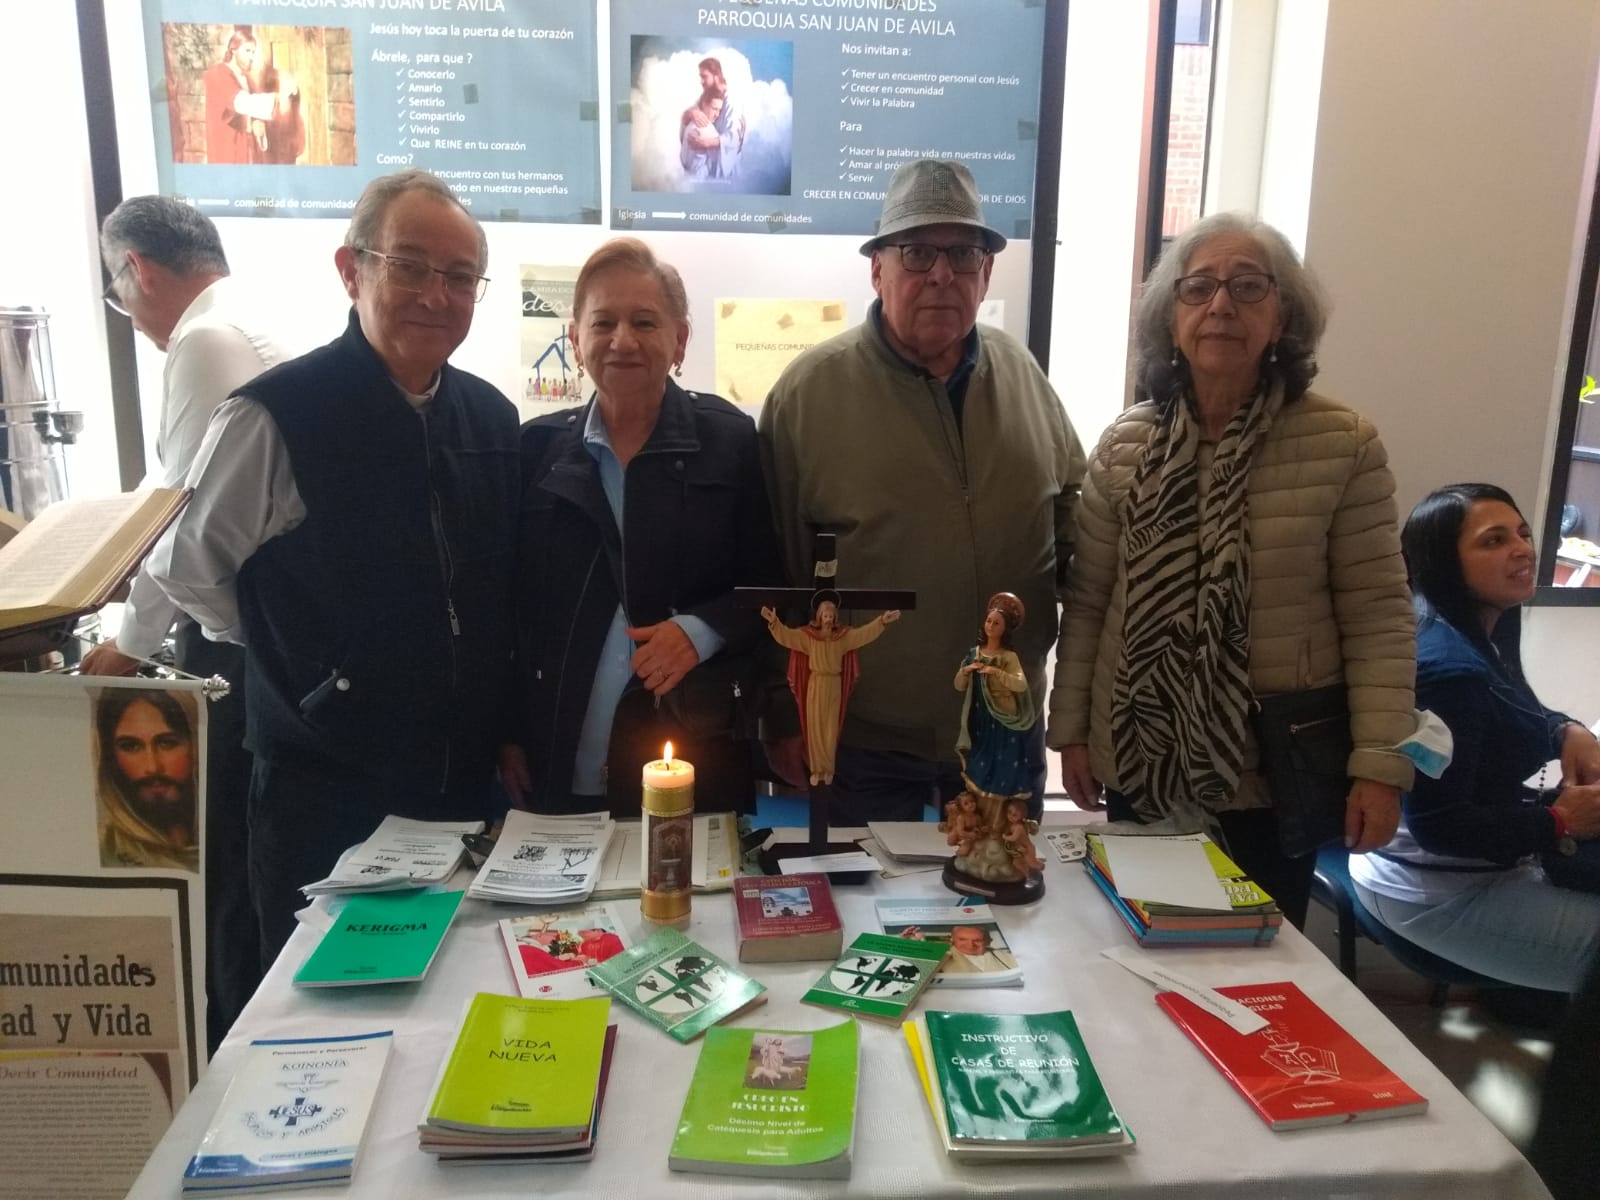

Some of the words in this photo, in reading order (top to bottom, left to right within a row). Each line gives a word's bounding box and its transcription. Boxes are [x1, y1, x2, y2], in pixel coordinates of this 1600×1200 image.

[379, 0, 425, 10] JUAN
[429, 0, 451, 11] DE
[456, 0, 505, 12] AVILA
[698, 8, 795, 30] PARROQUIA
[799, 14, 832, 31] SAN
[836, 16, 879, 33] JUAN
[884, 18, 905, 34] DE
[909, 20, 956, 37] AVILA
[369, 23, 399, 35] Jesús
[402, 24, 421, 37] hoy
[425, 26, 448, 36] toca
[450, 25, 460, 36] la
[463, 27, 499, 38] puerta
[501, 27, 516, 38] de
[518, 28, 529, 38] tu
[532, 28, 574, 40] corazón
[842, 43, 862, 54] Nos
[864, 44, 899, 56] invitan
[901, 48, 912, 57] a:
[371, 49, 411, 64] Ábrele,
[416, 54, 440, 65] para
[443, 54, 464, 65] que
[467, 53, 473, 63] ?
[408, 69, 455, 80] Conocerlo
[851, 69, 876, 80] Tener
[891, 72, 937, 82] encuentro
[939, 73, 977, 84] personal
[978, 76, 995, 84] con
[997, 75, 1020, 86] Jesús
[408, 83, 442, 93] Amarlo
[850, 83, 879, 94] Crecer
[881, 86, 893, 94] en
[895, 86, 944, 96] comunidad
[408, 97, 445, 107] Sentirlo
[850, 97, 870, 106] Vivir
[872, 98, 880, 107] la
[882, 98, 915, 109] Palabra
[409, 111, 465, 122] Compartirlo
[409, 124, 440, 135] Vivirlo
[840, 121, 863, 132] Para
[411, 138, 430, 149] Que
[435, 139, 463, 149] REINE
[464, 142, 476, 150] en
[478, 141, 489, 150] tu
[490, 140, 526, 151] corazón
[376, 153, 414, 166] Como?
[849, 147, 874, 157] Hacer
[876, 147, 885, 157] la
[887, 148, 919, 159] palabra
[922, 149, 940, 159] vida
[955, 151, 992, 161] nuestras
[993, 151, 1016, 161] vidas
[849, 160, 872, 170] Amar
[874, 160, 883, 170] al
[436, 168, 481, 180] encuentro
[483, 170, 500, 180] con
[501, 170, 516, 180] tus
[518, 170, 564, 181] hermanos
[849, 173, 874, 183] Servir
[448, 182, 467, 193] ndo
[469, 184, 482, 193] en
[484, 185, 522, 194] nuestras
[524, 183, 568, 195] pequeñas
[234, 197, 286, 208] comunidad
[287, 197, 299, 208] de
[803, 190, 837, 200] CRECER
[839, 191, 851, 200] EN
[991, 194, 1004, 203] DE
[1005, 194, 1026, 204] DIOS
[618, 209, 646, 221] Iglesia
[689, 210, 739, 222] comunidad
[741, 211, 752, 222] de
[753, 213, 812, 224] comunidades
[736, 341, 777, 351] PEQUEÑAS
[346, 922, 428, 932] KERIGMA
[0, 954, 156, 987] munidades
[0, 1004, 36, 1036] ad
[52, 1013, 72, 1043] y
[83, 1003, 152, 1036] Vida
[503, 1038, 552, 1049] VIDA
[961, 1033, 1049, 1043] INSTRUCTIVO
[488, 1050, 557, 1063] NUEVA
[1000, 1047, 1017, 1056] DE
[951, 1055, 993, 1068] CASAS
[998, 1058, 1014, 1068] DE
[1019, 1055, 1080, 1068] REUNIÓN
[45, 1065, 138, 1079] Comunidad
[763, 1128, 785, 1136] para
